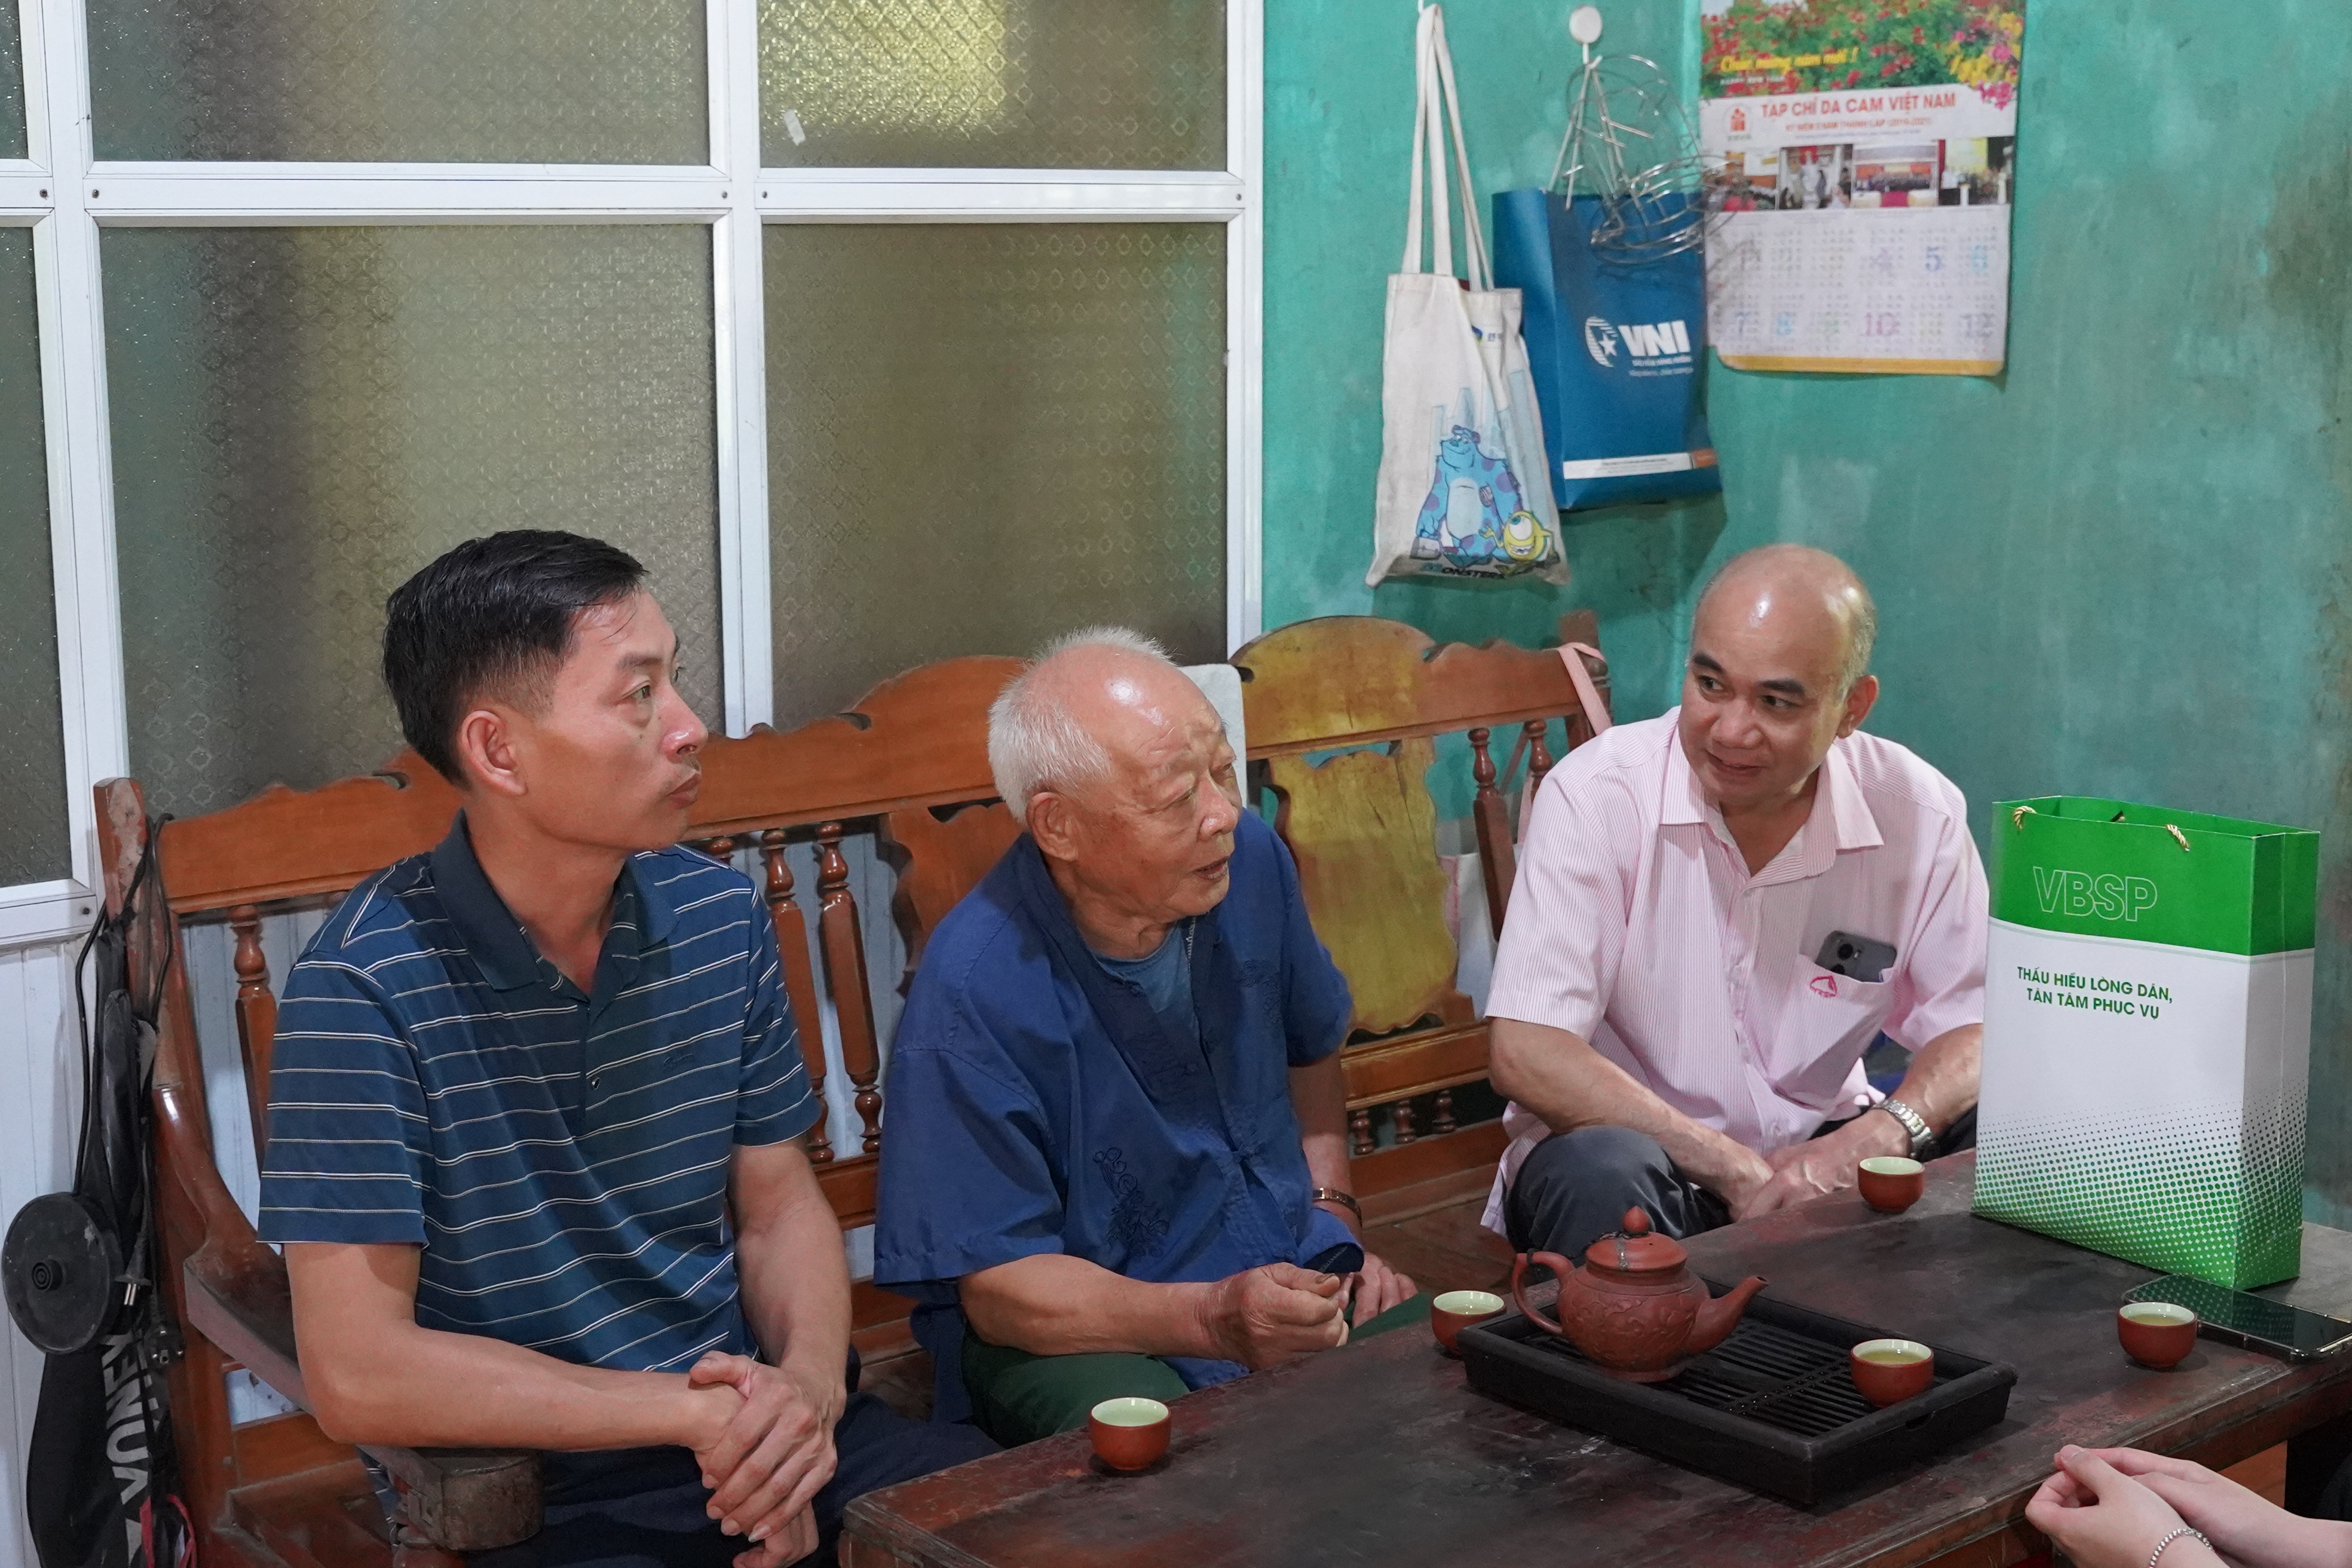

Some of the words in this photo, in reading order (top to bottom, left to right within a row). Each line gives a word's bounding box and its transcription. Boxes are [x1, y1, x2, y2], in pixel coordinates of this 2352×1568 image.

[1821, 100, 1840, 115] DA
[1846, 97, 1883, 113] CAM
[1923, 93, 1955, 108] NAM
[1618, 320, 1690, 357] VNI
[2033, 866, 2158, 922] VBSP
[2017, 966, 2050, 984] THẤU
[2090, 976, 2133, 995] LÒNG
[2137, 982, 2173, 1004] DÂN,
[2027, 987, 2053, 1004] TẬN
[2057, 992, 2088, 1009] TÂM
[2093, 997, 2135, 1015] PHỤC
[2140, 1003, 2160, 1021] VỤ
